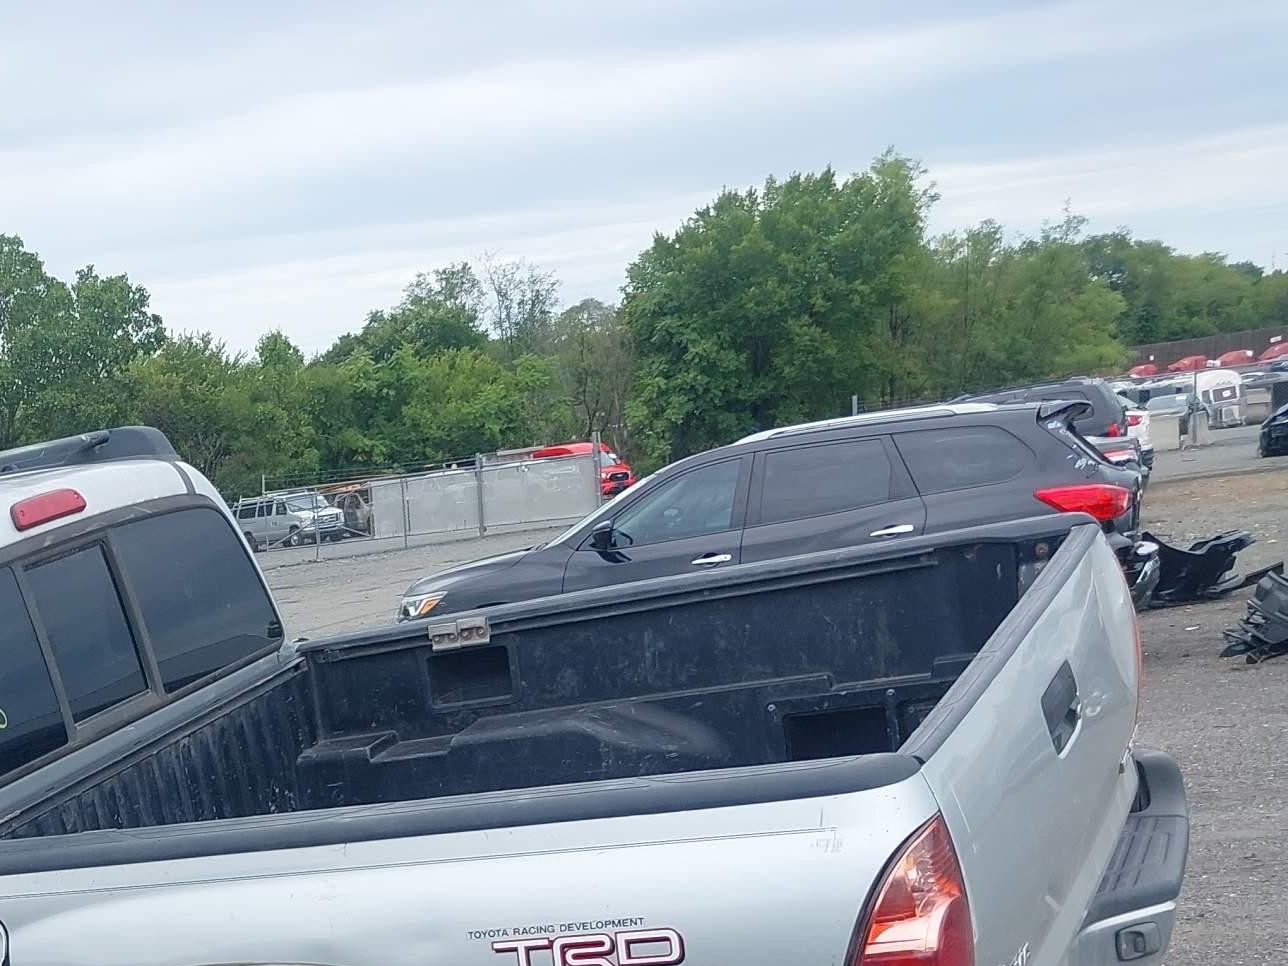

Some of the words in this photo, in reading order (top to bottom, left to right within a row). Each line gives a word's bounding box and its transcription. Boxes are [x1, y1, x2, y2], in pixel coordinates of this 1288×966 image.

[467, 928, 510, 940] TOYOTA
[513, 924, 555, 936] RACING
[559, 917, 644, 933] DEVELOPMENT
